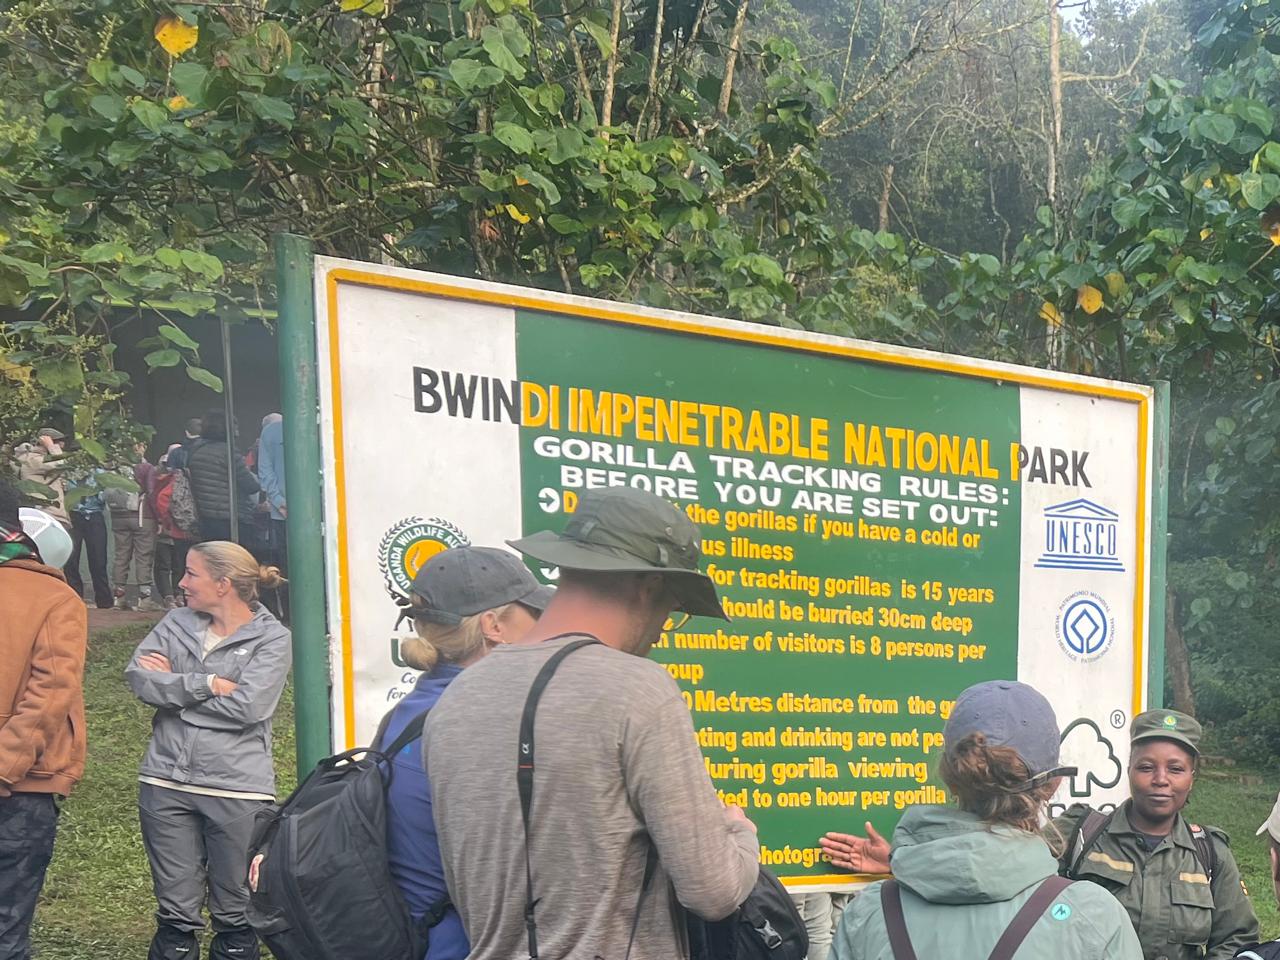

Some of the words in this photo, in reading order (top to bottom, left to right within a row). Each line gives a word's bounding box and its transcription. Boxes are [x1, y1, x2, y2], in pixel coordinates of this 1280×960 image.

[413, 366, 560, 430] BWINDI
[568, 387, 829, 461] IMPENETRABLE
[844, 421, 999, 480] NATIONAL
[1010, 442, 1093, 488] PARK
[533, 435, 696, 474] GORILLA
[708, 454, 882, 493] TRACKING
[899, 475, 1010, 505] RULES:
[560, 464, 699, 500] BEFORE
[713, 481, 782, 507] YOU
[791, 490, 854, 515] ARE
[861, 497, 920, 521] SET
[929, 503, 998, 527] OUT:
[563, 490, 578, 513] D
[397, 526, 444, 546] WILDLIFE
[686, 504, 720, 525] the
[725, 509, 798, 532] gorillas
[803, 513, 818, 533] if
[821, 519, 854, 540] you
[858, 518, 900, 542] have
[905, 528, 916, 543] a
[921, 527, 958, 547] cold
[962, 532, 981, 548] or
[1046, 520, 1117, 556] UNESCO
[731, 537, 794, 561] illness
[390, 547, 411, 590] UGANDA
[706, 564, 736, 585] for
[739, 567, 820, 597] tracking
[824, 575, 892, 598] gorillas
[901, 579, 916, 599] is
[922, 581, 942, 601] 15
[948, 587, 994, 606] years
[722, 596, 775, 619] hould
[779, 600, 804, 621] be
[808, 602, 874, 626] burried
[878, 607, 926, 629] 30cm
[931, 612, 972, 636] deep
[674, 629, 749, 651] number
[753, 631, 773, 651] of
[777, 632, 846, 654] visitors
[850, 635, 866, 655] is
[870, 635, 881, 656] 8
[885, 640, 953, 660] persons
[958, 644, 986, 662] per
[694, 690, 773, 712] Metres
[777, 693, 854, 713] distance
[858, 694, 898, 714] from
[907, 696, 936, 715] the
[695, 727, 737, 752] ting
[742, 727, 776, 747] and
[780, 727, 853, 752] drinking
[857, 731, 886, 747] are
[891, 728, 919, 748] not
[704, 757, 766, 784] uring
[772, 757, 838, 785] gorilla
[848, 757, 928, 783] viewing
[753, 788, 772, 807] to
[777, 791, 811, 807] one
[816, 787, 857, 807] hour
[861, 793, 890, 810] per
[894, 786, 946, 809] gorilla
